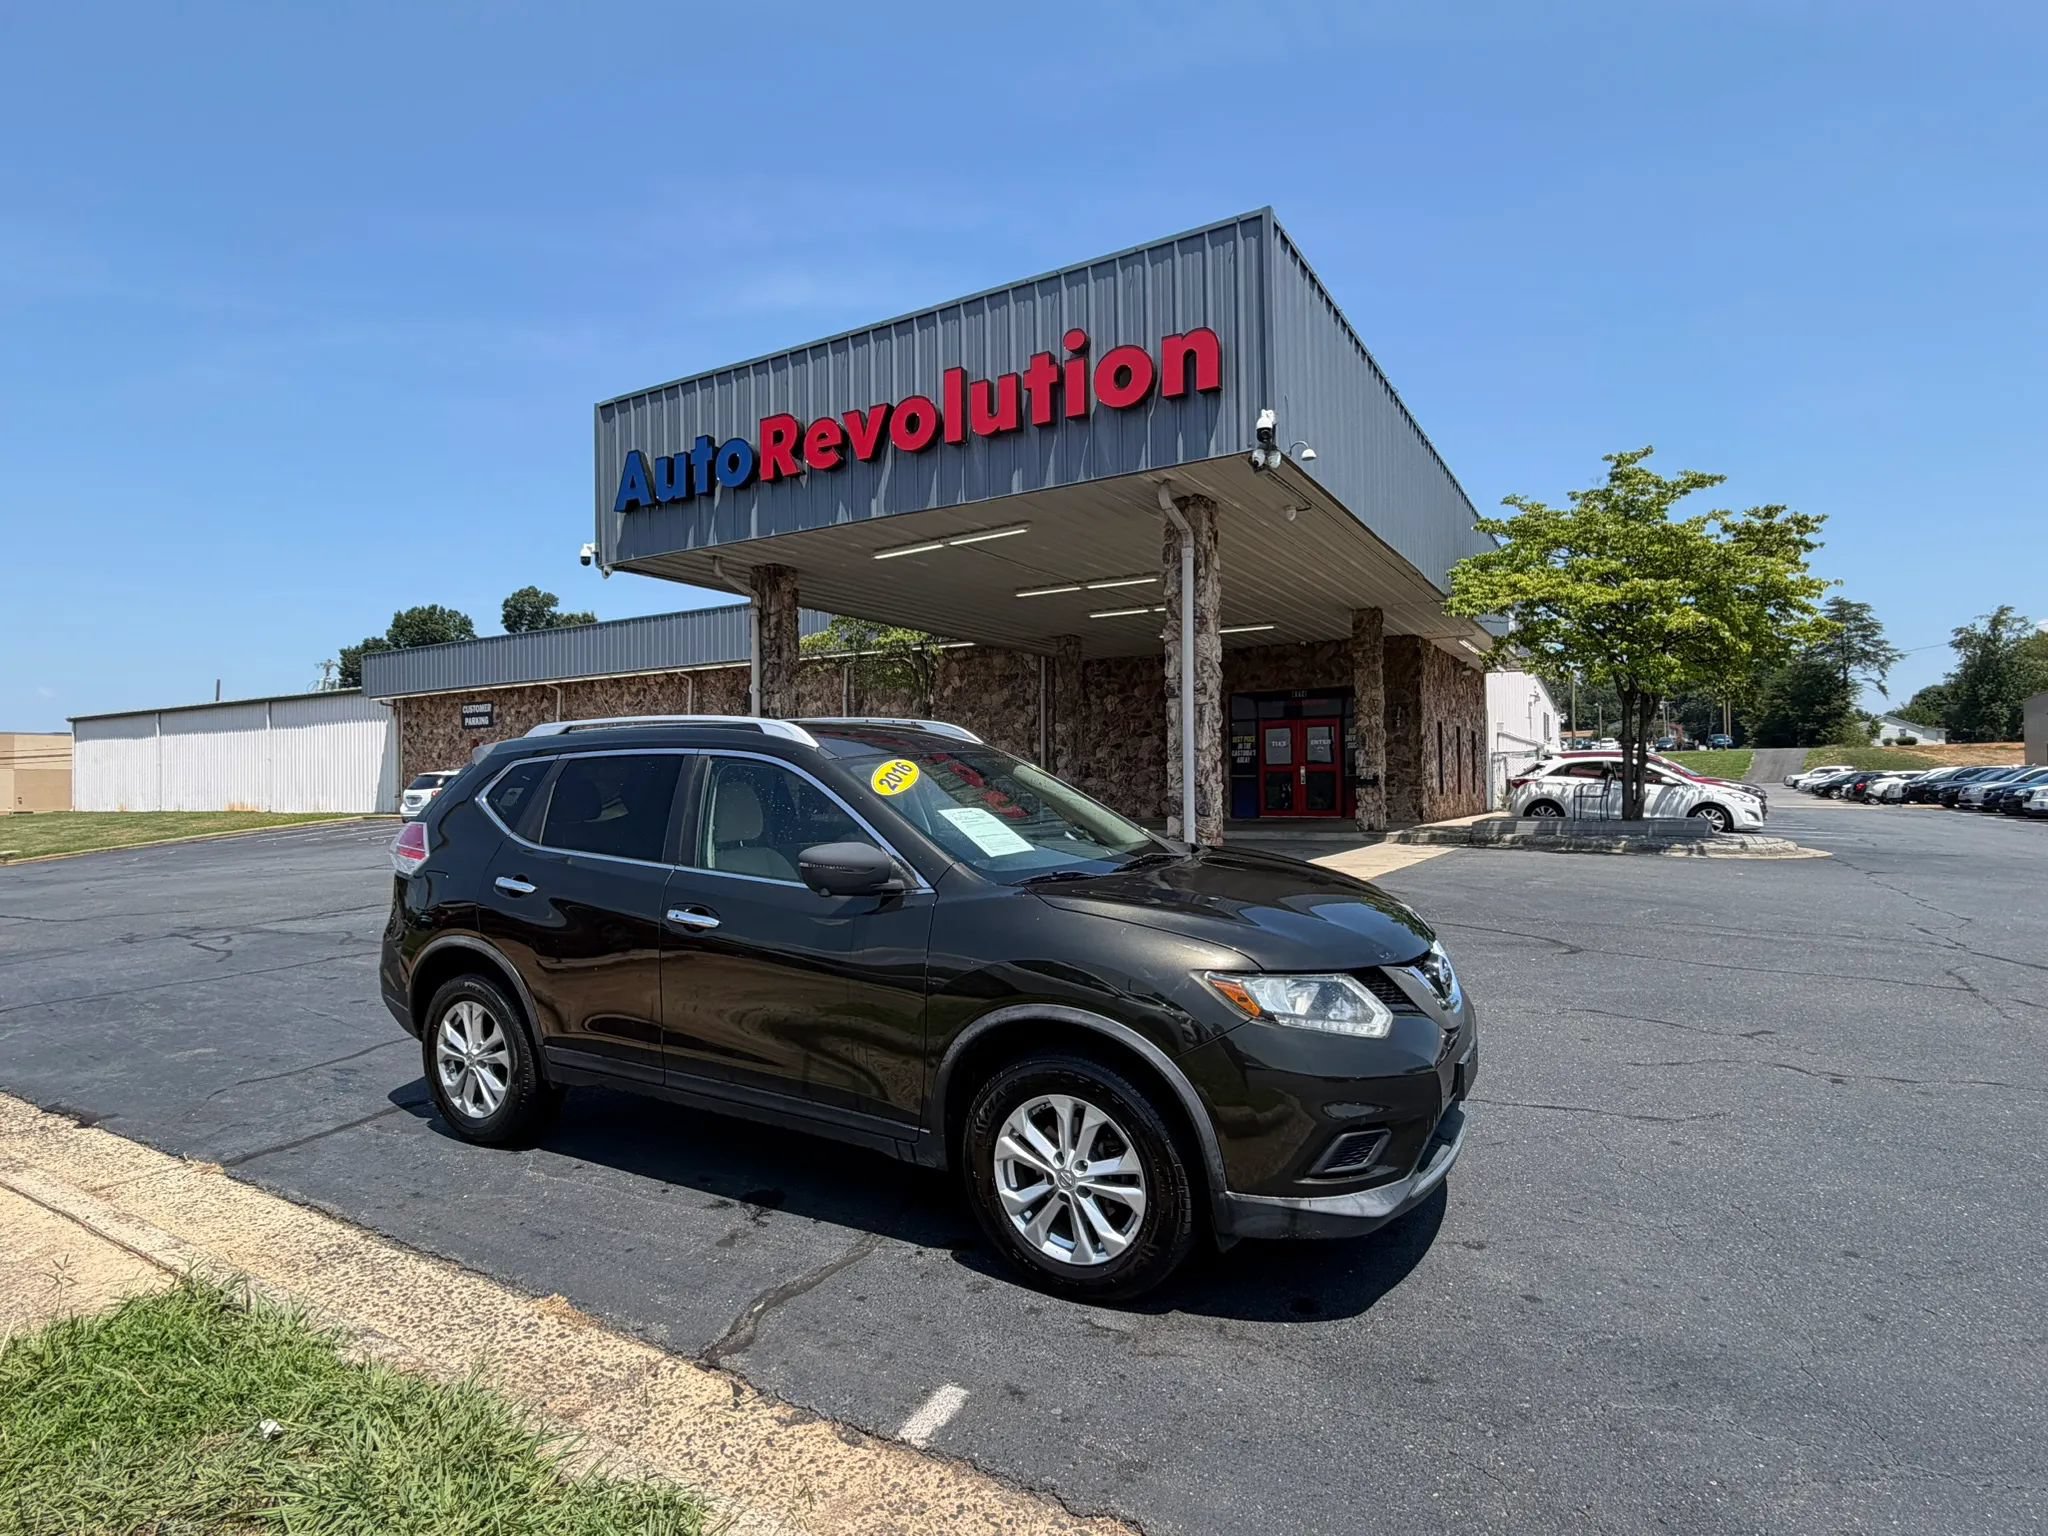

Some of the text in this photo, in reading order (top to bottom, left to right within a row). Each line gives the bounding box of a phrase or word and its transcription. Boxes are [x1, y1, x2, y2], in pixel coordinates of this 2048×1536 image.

[613, 326, 1223, 513] AutoRevolution
[462, 703, 492, 713] CUSTOMER
[464, 716, 489, 726] PARKING
[878, 761, 913, 791] 2016
